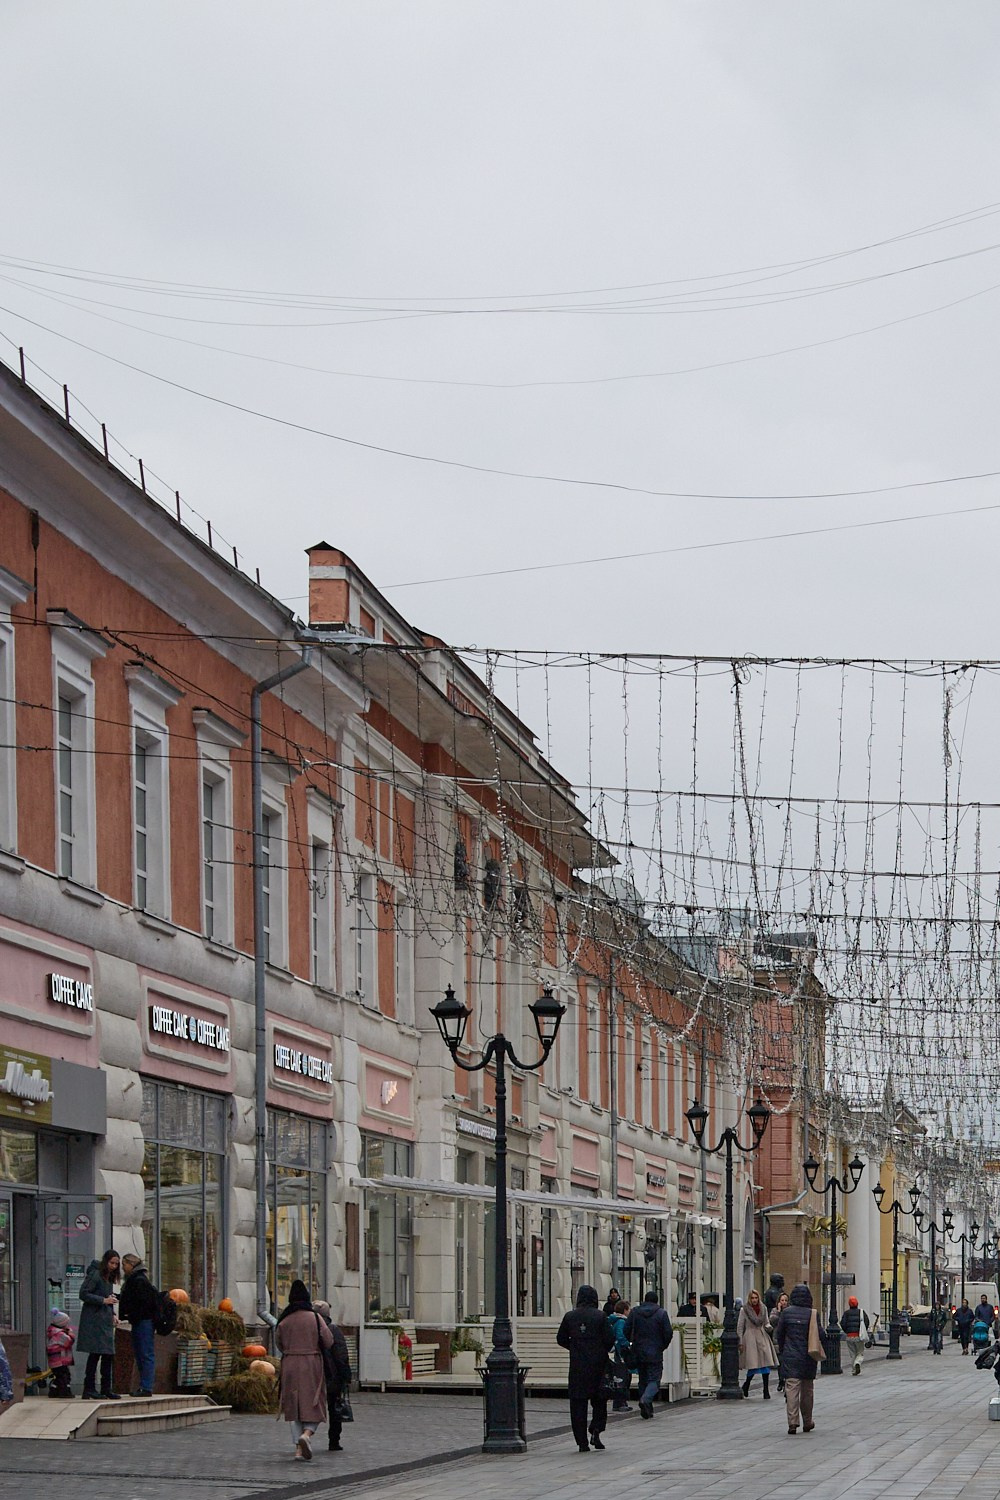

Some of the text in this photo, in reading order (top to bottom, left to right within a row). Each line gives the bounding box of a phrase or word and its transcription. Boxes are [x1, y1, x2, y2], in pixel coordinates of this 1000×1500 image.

[52, 973, 93, 1011] COFFEE CAKE
[152, 1005, 230, 1051] COFFEE CAKE COFFEE CAKE
[275, 1044, 333, 1084] COFFEE CAKE COFFEE CAKE
